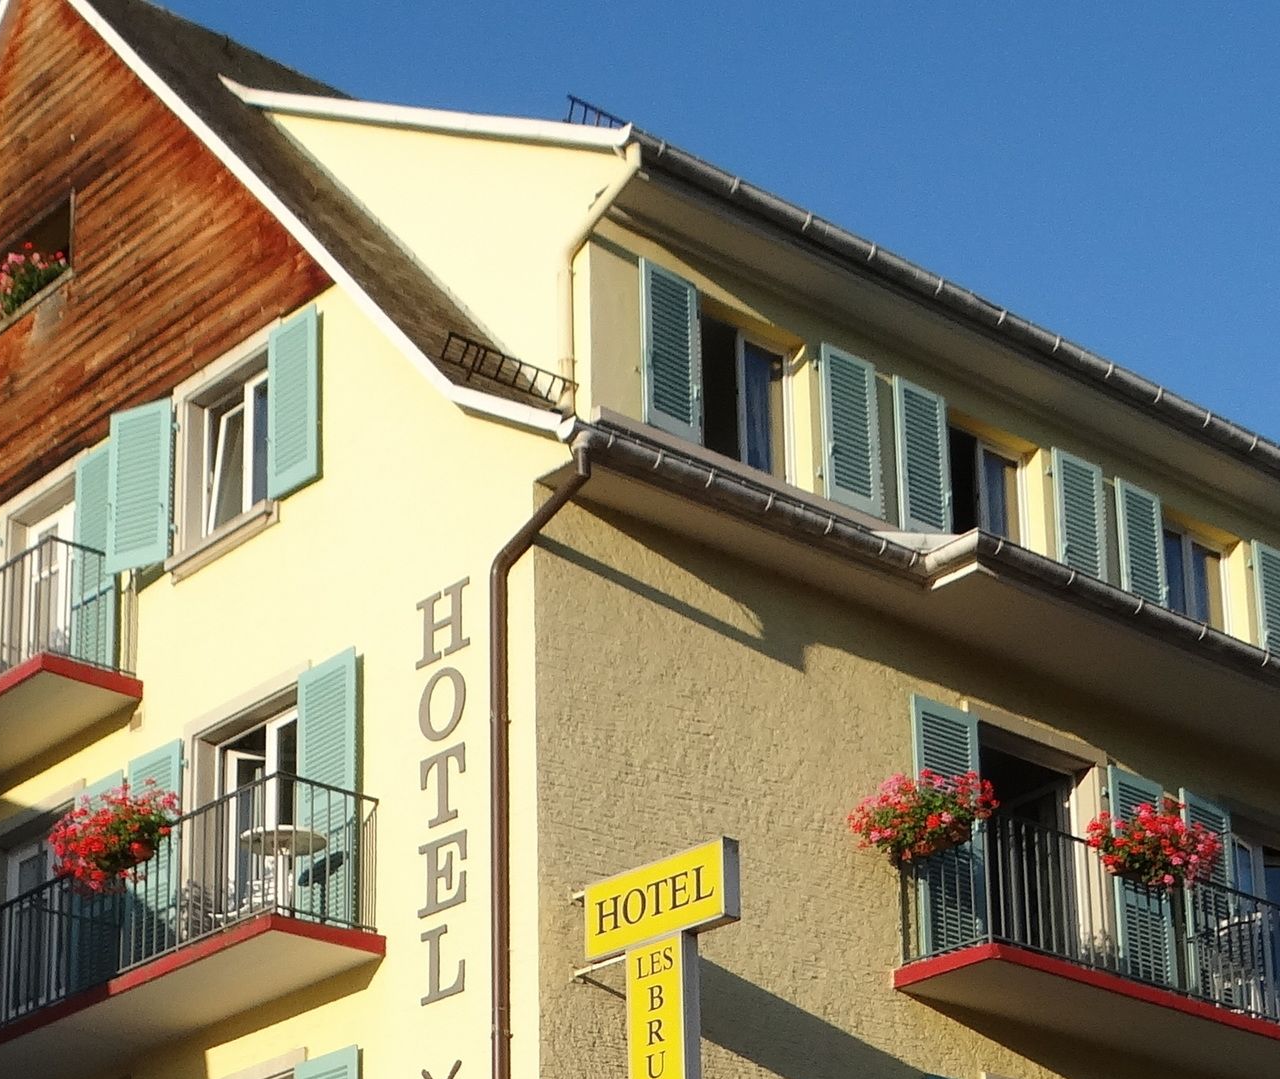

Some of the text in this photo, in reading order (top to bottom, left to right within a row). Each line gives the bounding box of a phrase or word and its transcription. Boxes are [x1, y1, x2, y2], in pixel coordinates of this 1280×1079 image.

[416, 576, 470, 1006] HOTEL
[595, 866, 715, 936] HOTEL
[636, 946, 674, 980] LES
